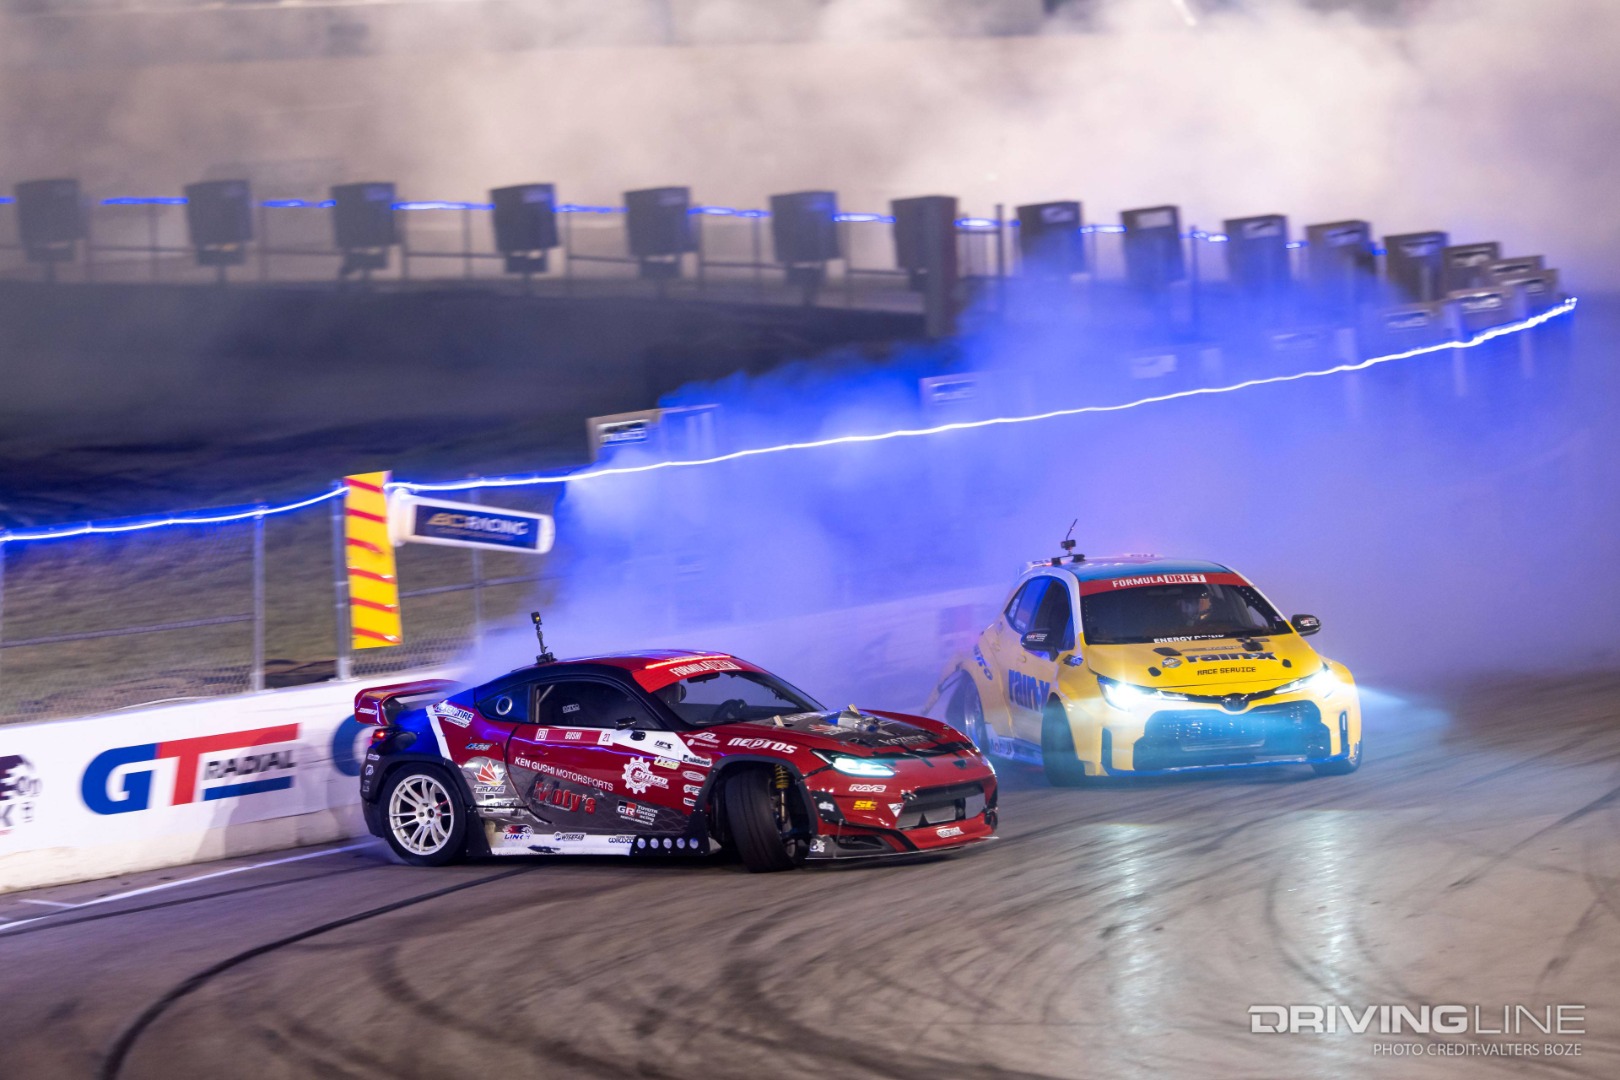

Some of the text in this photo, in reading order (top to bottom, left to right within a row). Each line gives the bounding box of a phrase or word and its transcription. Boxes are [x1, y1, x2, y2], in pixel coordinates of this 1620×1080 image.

[1112, 573, 1207, 588] FORMULA DRIFT
[1153, 635, 1192, 643] ENERGY
[1197, 666, 1257, 676] RACE SERVICE
[564, 731, 582, 740] GUSHI
[727, 737, 798, 754] nepros
[203, 749, 298, 782] RADIAL
[81, 736, 303, 815] GT
[515, 756, 614, 791] KEN GUSHI MOTORSPORTS
[849, 784, 886, 792] RAYS
[617, 806, 635, 816] GR
[637, 805, 658, 814] TOYOTA
